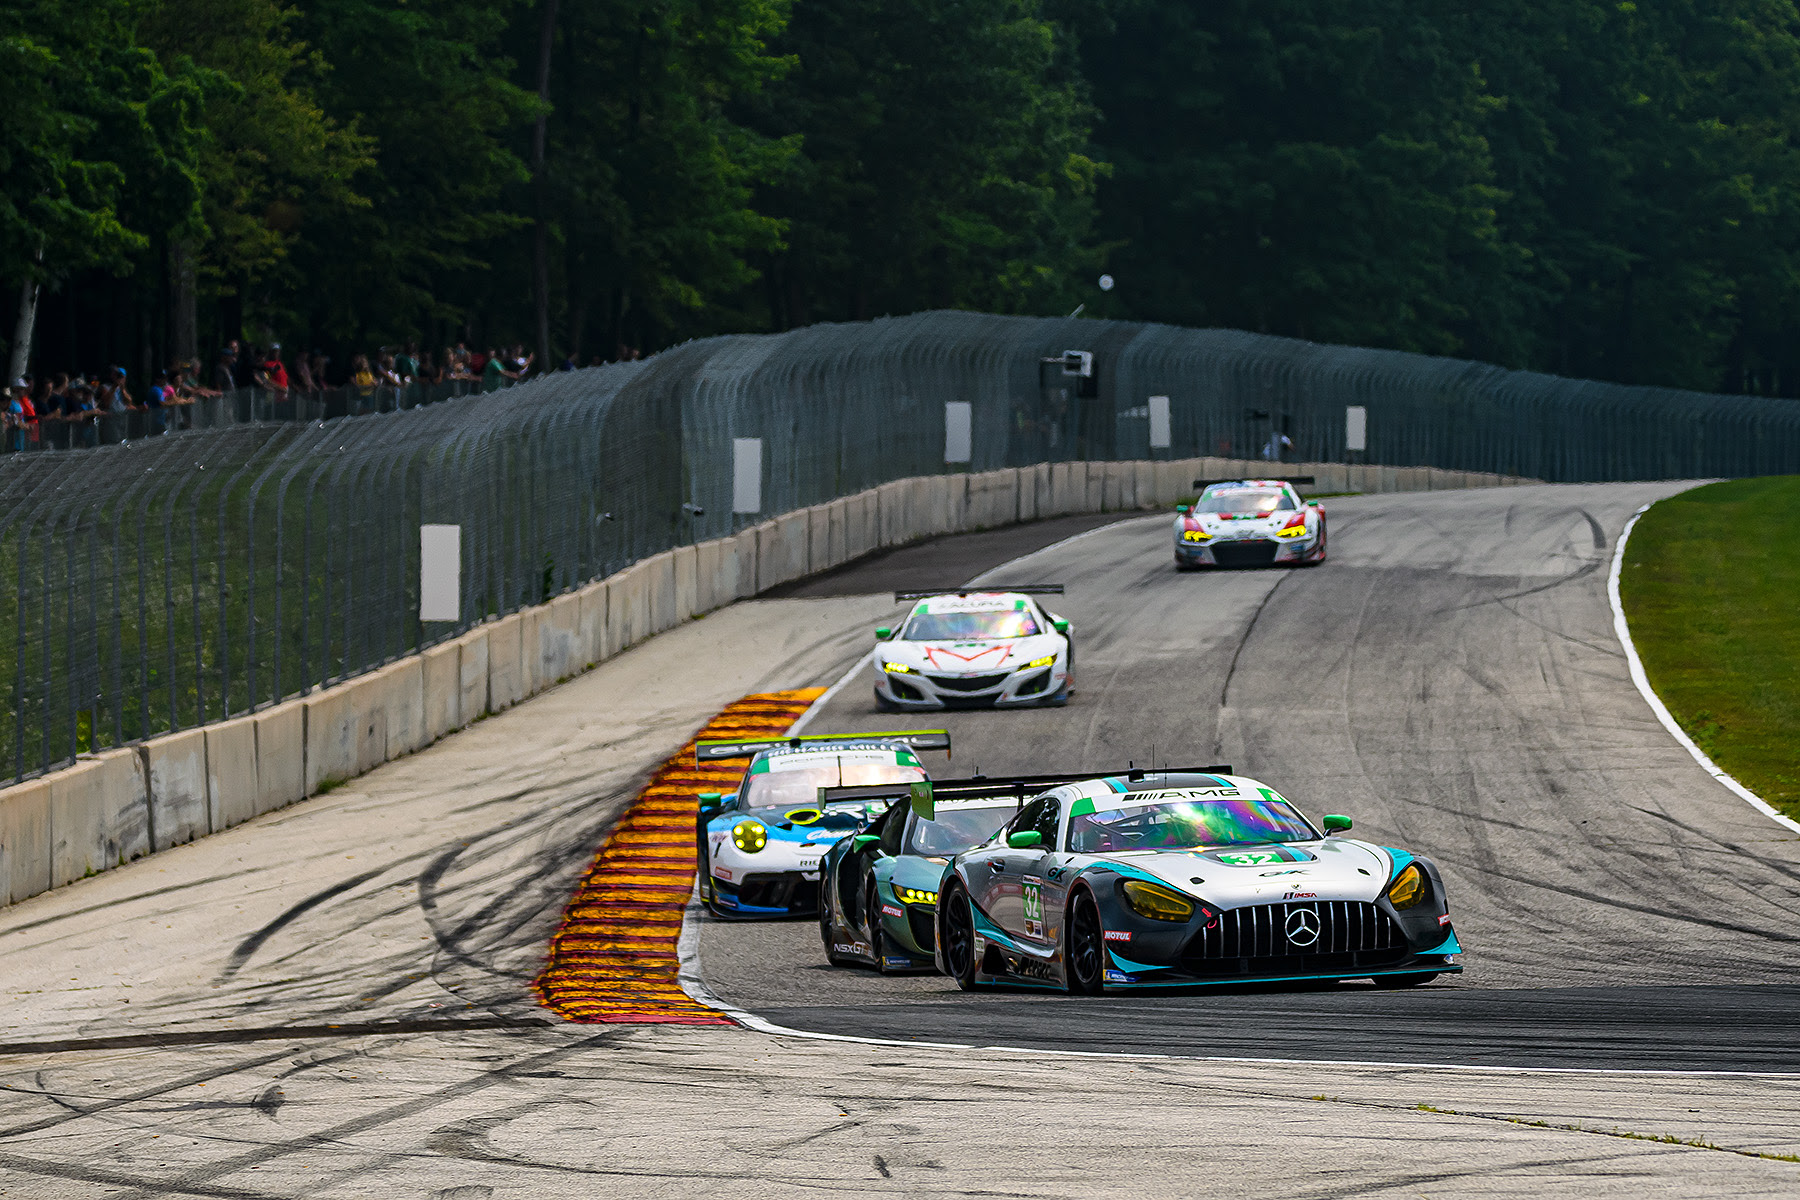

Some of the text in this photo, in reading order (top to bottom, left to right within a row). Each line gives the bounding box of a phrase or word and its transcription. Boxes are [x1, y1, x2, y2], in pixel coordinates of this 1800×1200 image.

[1159, 788, 1241, 800] AMG
[1229, 854, 1277, 866] 32
[1025, 886, 1040, 918] 32
[882, 906, 902, 917] MOTUL
[1104, 931, 1131, 941] MOTUL
